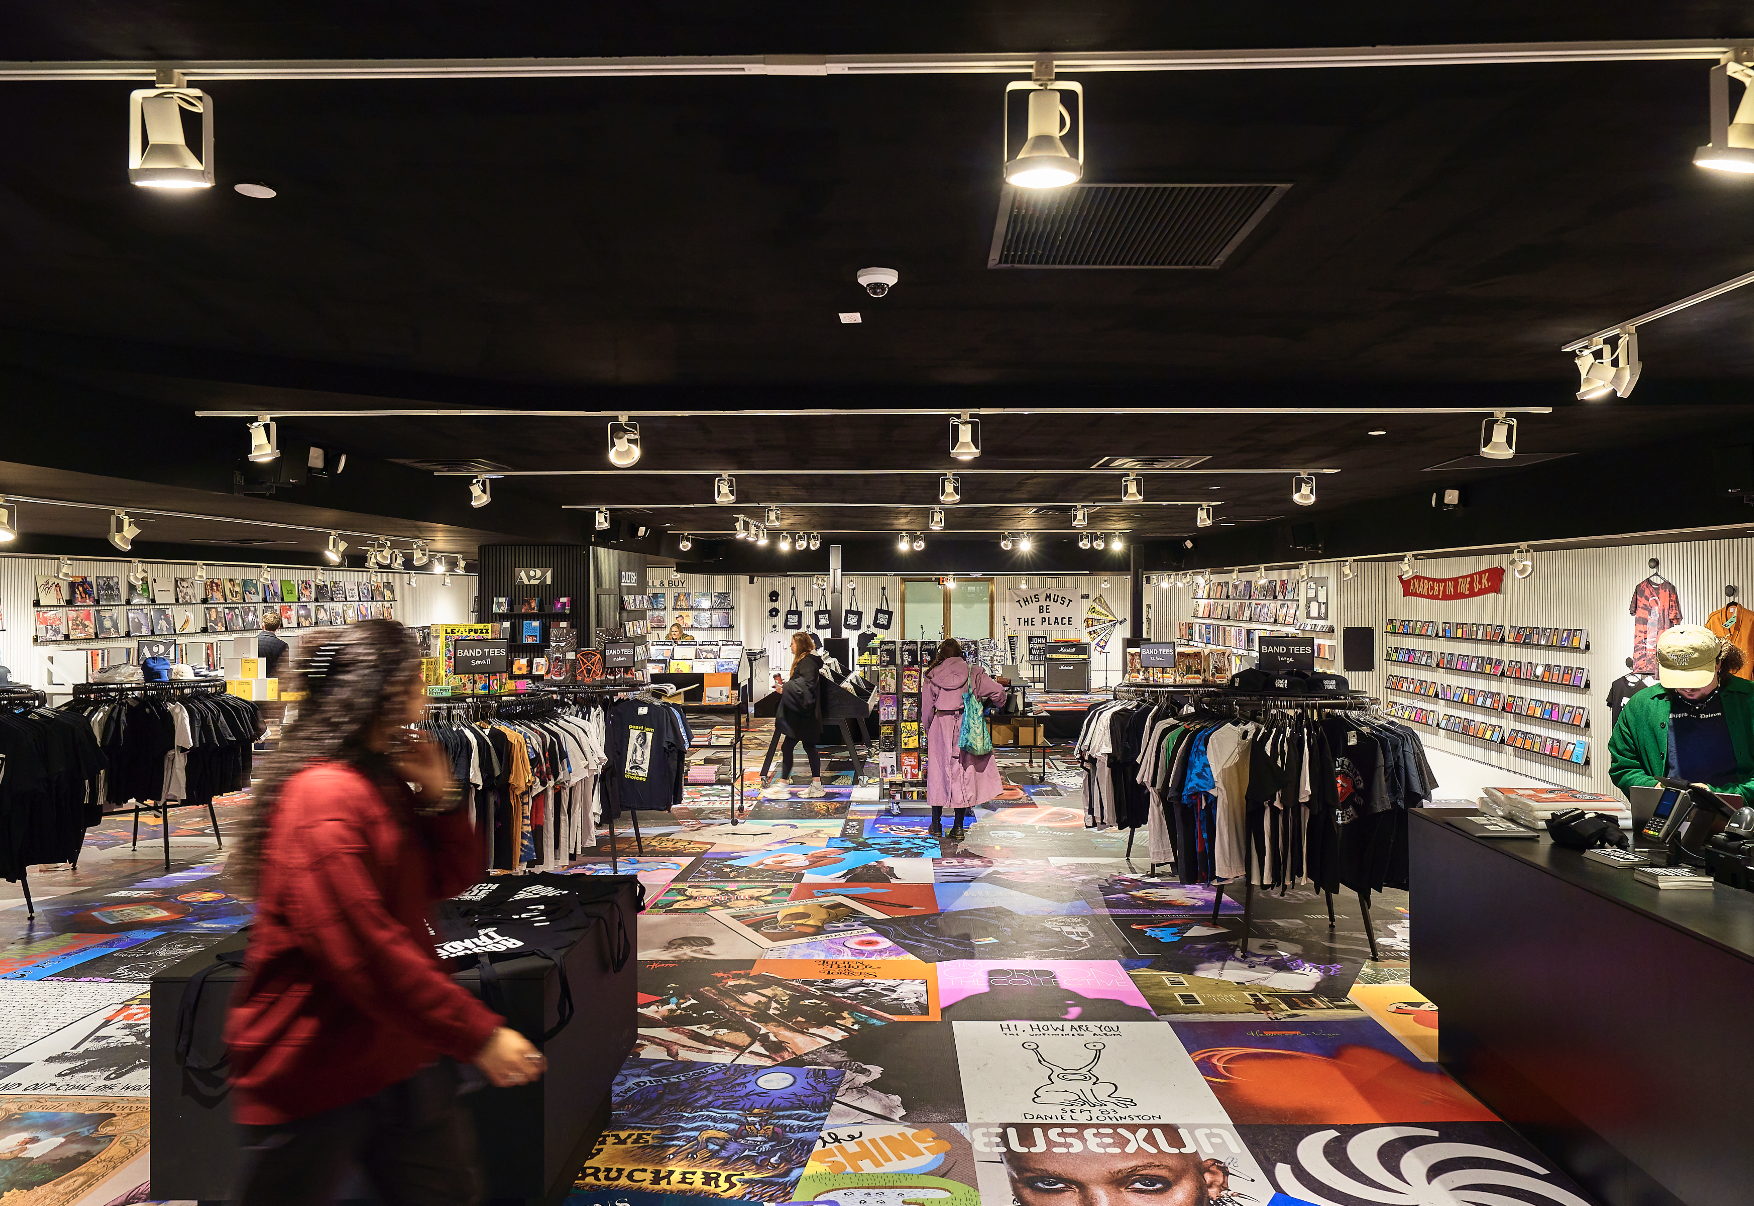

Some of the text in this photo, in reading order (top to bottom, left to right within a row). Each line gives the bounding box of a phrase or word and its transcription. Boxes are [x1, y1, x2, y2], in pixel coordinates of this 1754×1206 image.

[1409, 578, 1444, 598] ANARCHY
[1446, 580, 1454, 595] IN
[1457, 577, 1471, 594] THE
[1016, 592, 1073, 609] THIS MUST
[1038, 604, 1051, 614] BE
[1017, 616, 1073, 627] THE PLACE
[457, 648, 506, 657] BAND TEES
[1159, 648, 1174, 656] TEES
[1261, 645, 1312, 655] BAND TEES
[943, 968, 1125, 980] GORDON
[1029, 1024, 1065, 1033] HOW
[1070, 1024, 1092, 1033] ARE
[1022, 1112, 1163, 1123] DANIEL JOHNSTON
[818, 1129, 863, 1149] the
[971, 1126, 1242, 1155] EUSEXUA
[813, 1127, 953, 1175] SHINS
[575, 1166, 747, 1194] RUCKERS
